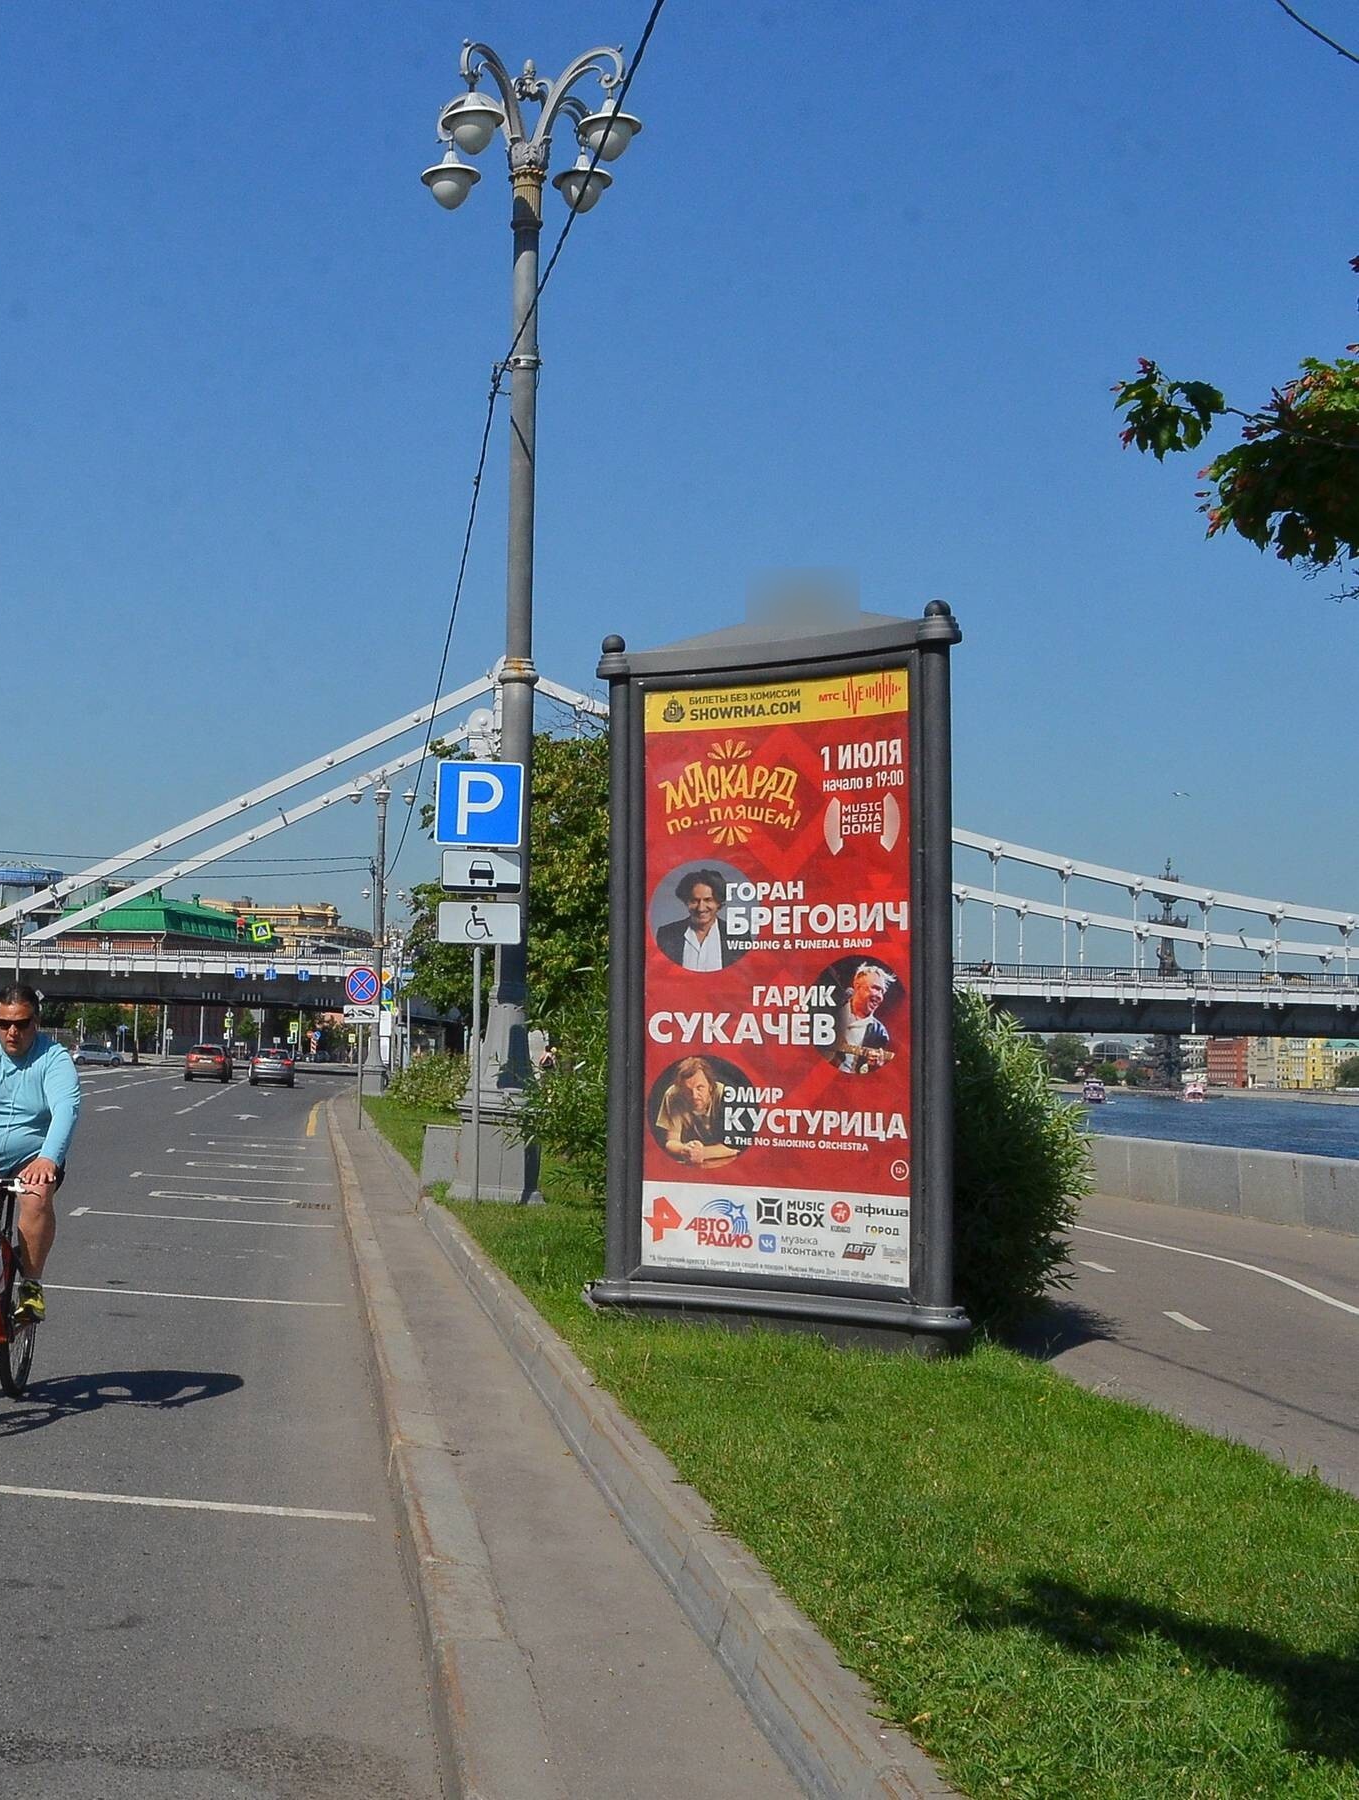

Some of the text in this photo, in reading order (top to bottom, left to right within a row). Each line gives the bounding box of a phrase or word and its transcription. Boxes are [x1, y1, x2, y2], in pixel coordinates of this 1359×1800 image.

[689, 688, 801, 705] БИЛЕТЫ БЕЗ КОМИССИИ
[690, 700, 801, 721] SHOWRMA.COM
[820, 739, 903, 771] 1 ИЮЛЯ
[657, 760, 799, 815] МАСКАРАД
[822, 769, 904, 792] начало в 19:00
[456, 771, 504, 835] P
[842, 802, 882, 814] MUSIC
[842, 812, 882, 824] MEDIA
[842, 822, 882, 835] DOME
[726, 880, 804, 901] ГОРАН
[726, 901, 909, 935] БРЕГОВИЧ
[782, 939, 792, 949] &
[752, 985, 837, 1007] ГАРИК
[648, 1004, 837, 1045] СУКАЧЁВ
[723, 1086, 784, 1104] ЭМИР
[724, 1107, 908, 1141] КУСТУРИЦА
[723, 1136, 732, 1145] &
[787, 1200, 825, 1212] MUSIC
[854, 1203, 909, 1217] афиша
[684, 1217, 730, 1232] АВТО
[787, 1212, 825, 1228] BOX
[697, 1231, 753, 1248] РАДИО
[781, 1235, 818, 1246] музыка
[781, 1246, 836, 1259] вконтакте
[845, 1243, 874, 1254] АВТО
